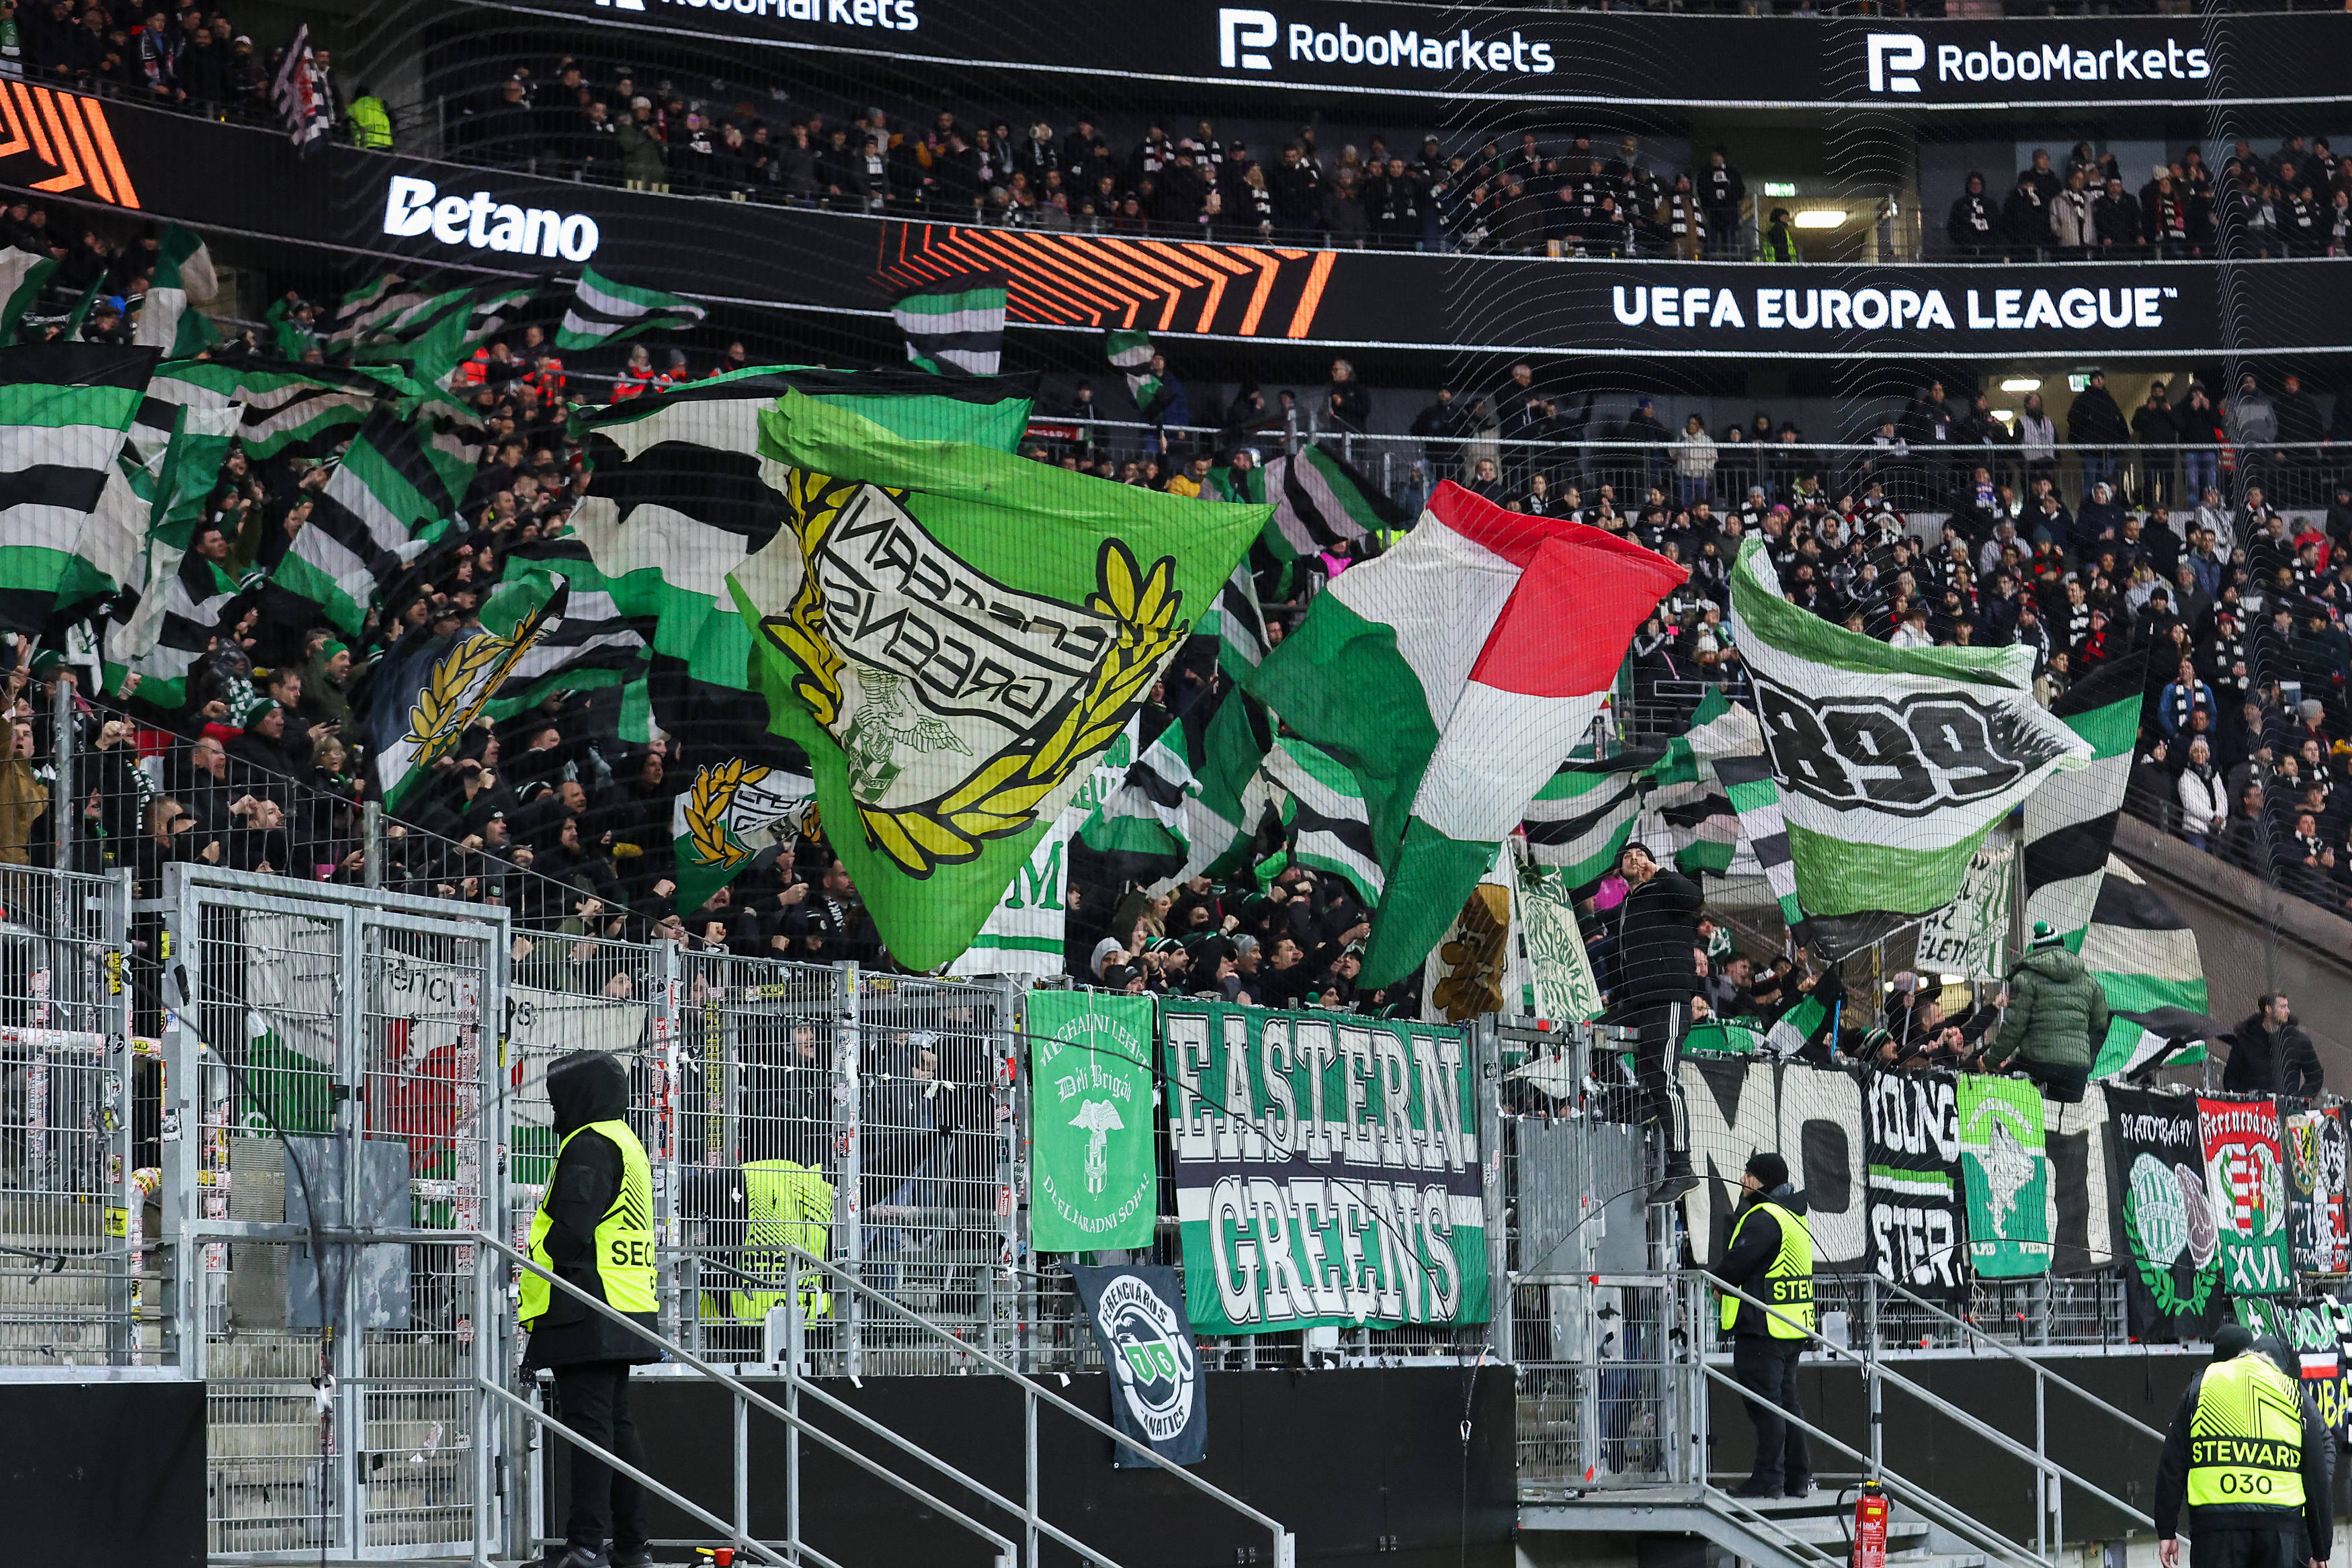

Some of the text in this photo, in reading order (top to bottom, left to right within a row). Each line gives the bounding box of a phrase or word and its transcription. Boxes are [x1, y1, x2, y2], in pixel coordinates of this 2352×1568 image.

[1289, 22, 1555, 73] RoboMarkets
[1938, 38, 2211, 81] RoboMarkets
[384, 175, 599, 262] Betano
[1613, 286, 1745, 328] UEFA
[1757, 288, 1955, 330] EUROPA
[1164, 1012, 1466, 1174] EASTERN
[1868, 1070, 1962, 1164] YOUNG
[611, 1239, 655, 1268] SEC
[1210, 1174, 1462, 1325] GREENS
[2227, 1245, 2292, 1289] XVI.
[1102, 1282, 1168, 1328] FERENCVÁROS
[1140, 1405, 1186, 1436] ANATICS
[2191, 1439, 2302, 1469] STEWARD
[2220, 1473, 2273, 1495] 030
